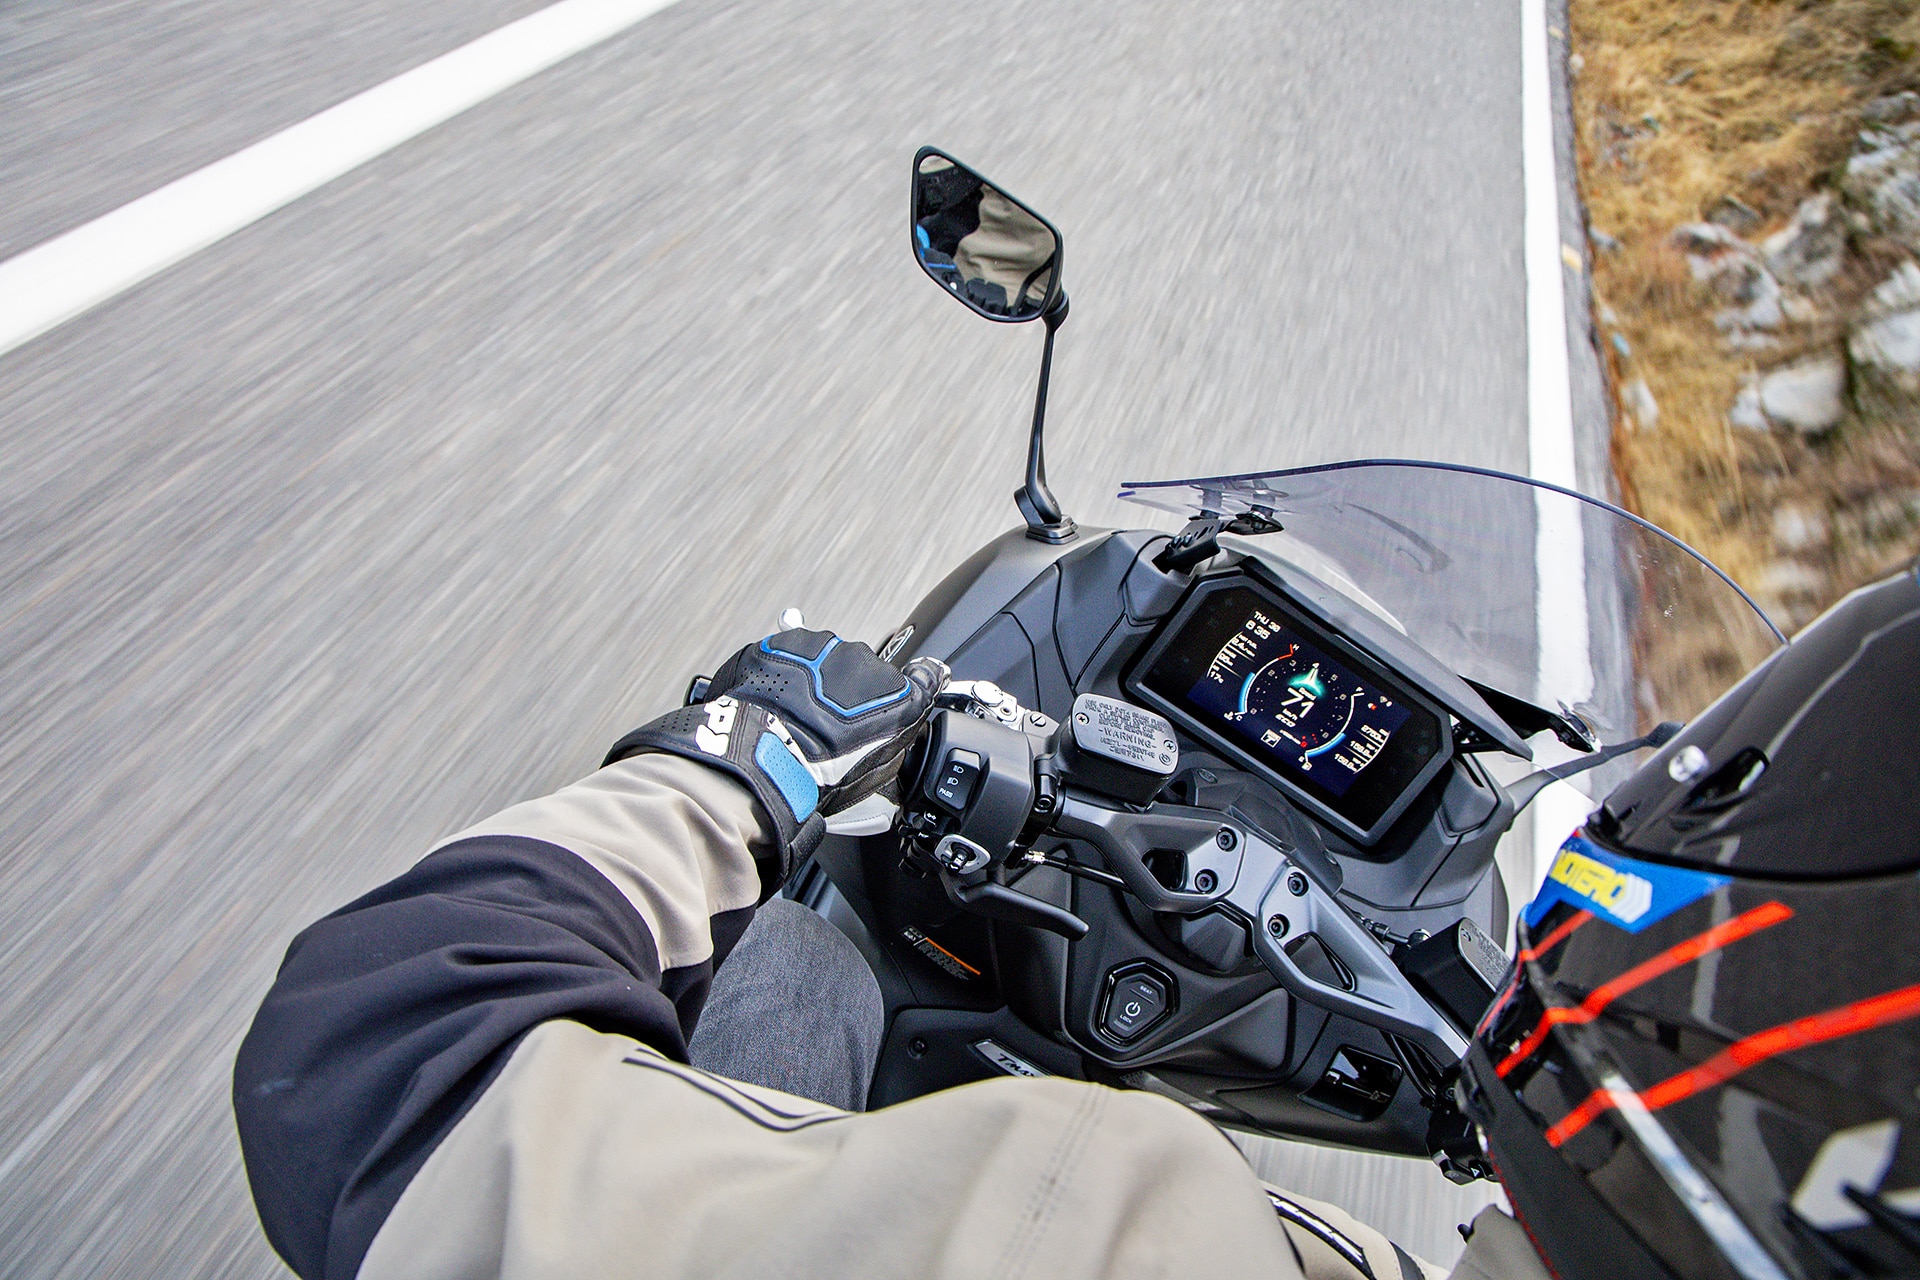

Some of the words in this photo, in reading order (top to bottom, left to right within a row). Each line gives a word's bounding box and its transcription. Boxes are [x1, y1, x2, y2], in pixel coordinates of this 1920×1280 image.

[1253, 610, 1270, 625] THU
[1267, 669, 1275, 677] 2
[1339, 693, 1347, 701] 6
[1287, 687, 1315, 719] 71
[938, 787, 954, 799] PASS
[1139, 985, 1153, 995] SEAT
[1119, 1014, 1132, 1024] LOCK
